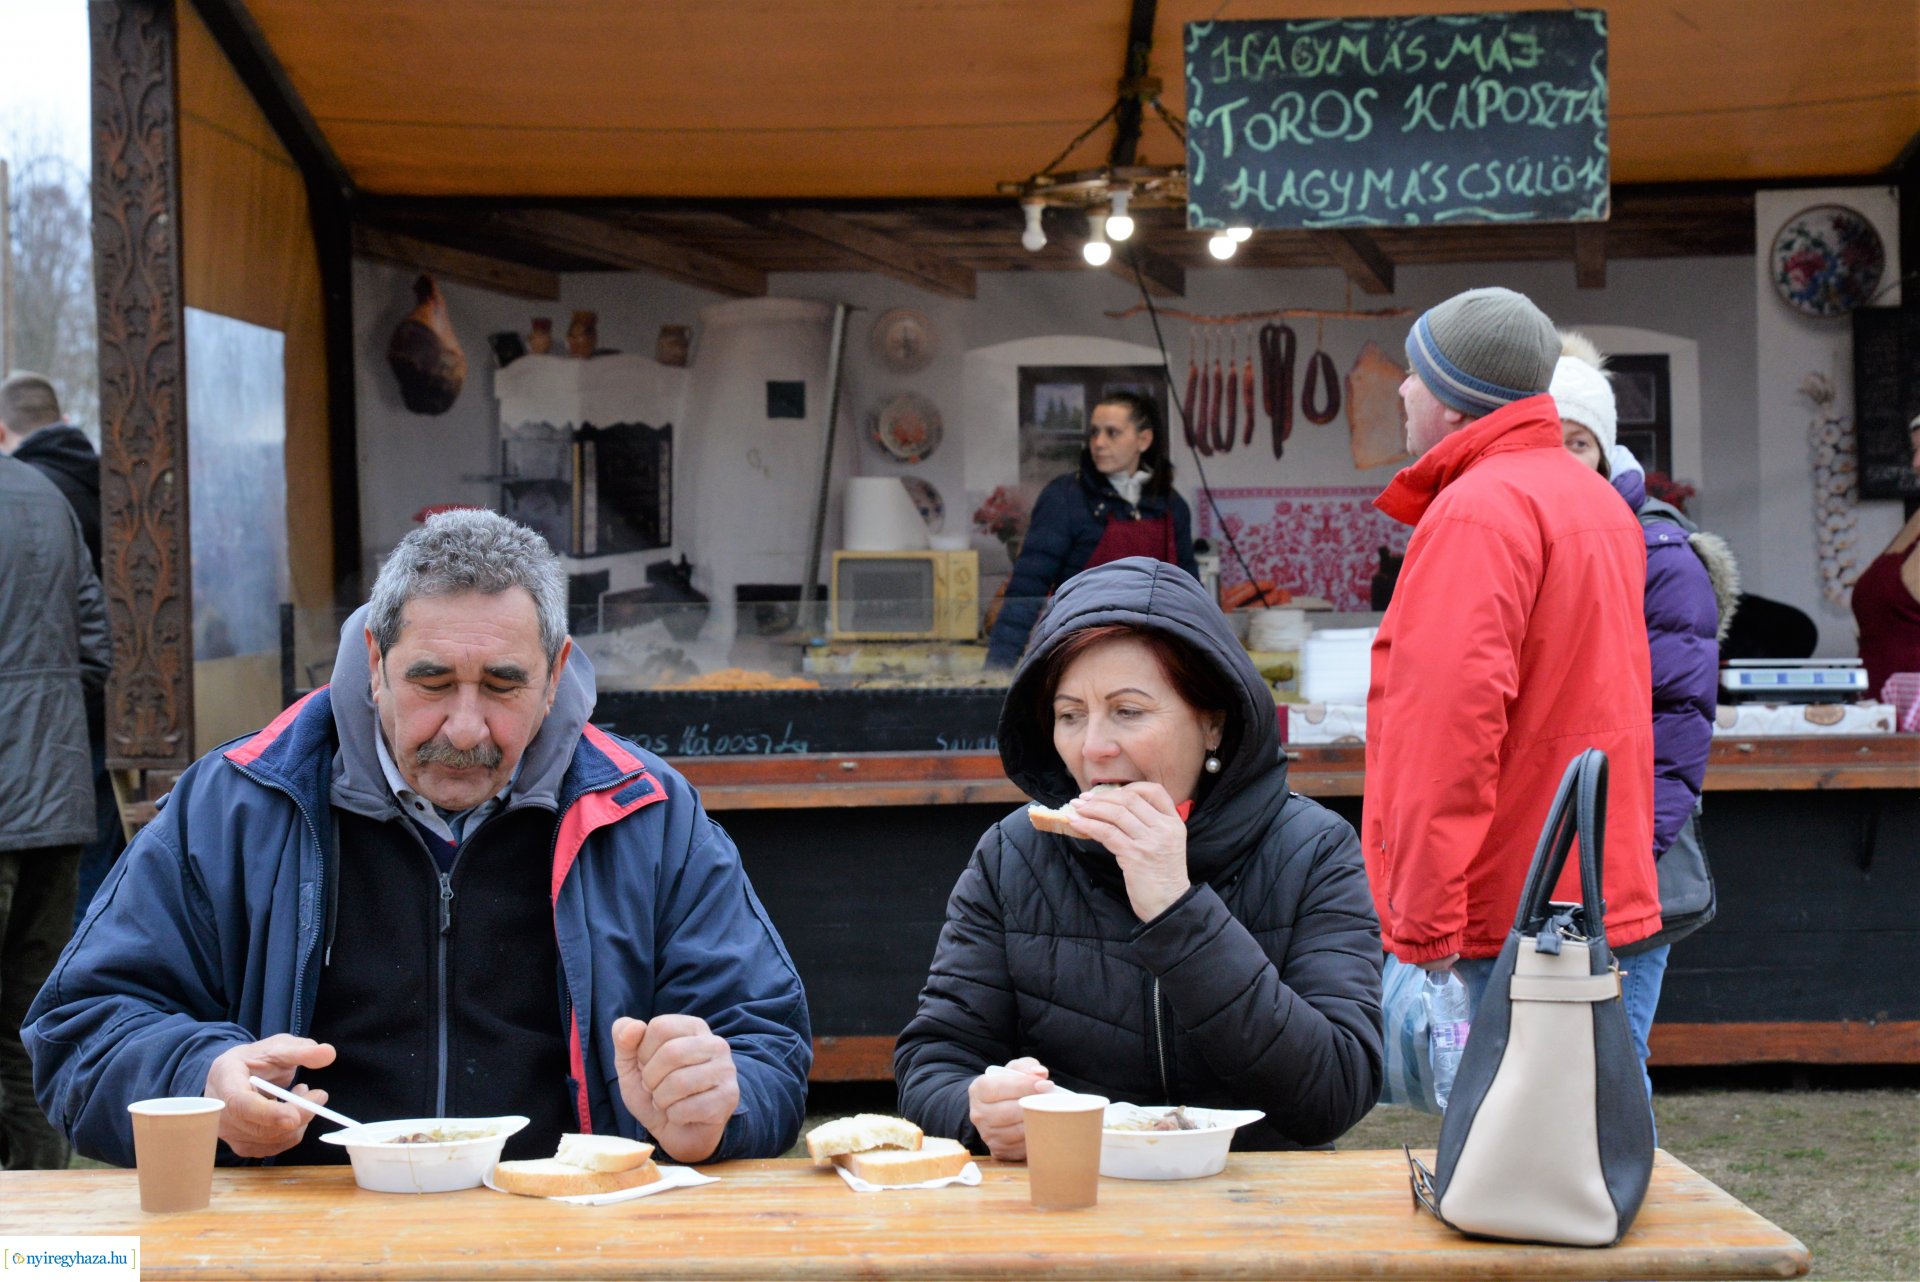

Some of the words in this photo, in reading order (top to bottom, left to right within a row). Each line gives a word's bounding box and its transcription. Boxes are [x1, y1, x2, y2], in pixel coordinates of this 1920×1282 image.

[1210, 29, 1428, 84] HAGYMÁS
[1205, 87, 1379, 158] TOROS
[1401, 75, 1608, 133] KÁPOSZTA
[1223, 160, 1449, 217] HAGYMÁS
[1457, 155, 1606, 201] CSÜLÖK
